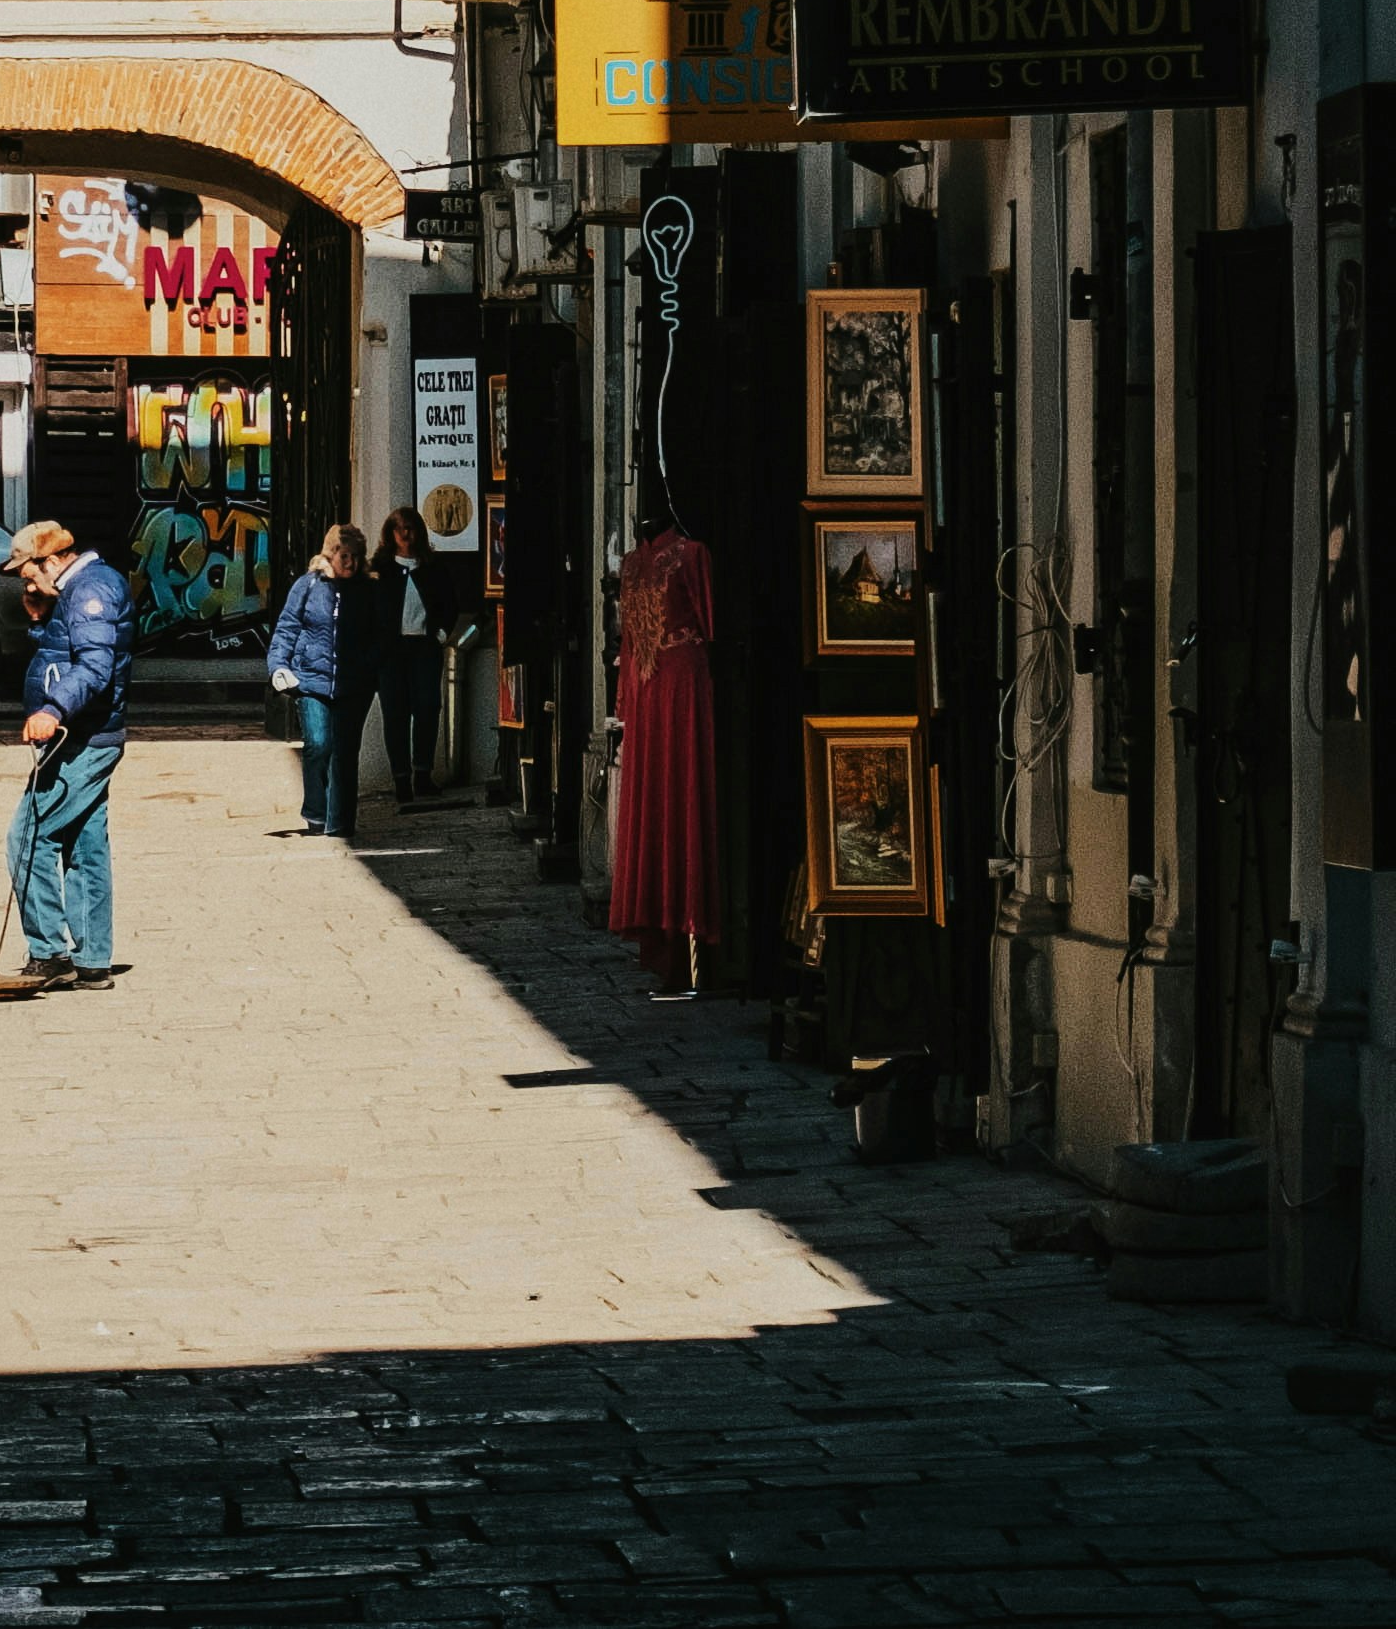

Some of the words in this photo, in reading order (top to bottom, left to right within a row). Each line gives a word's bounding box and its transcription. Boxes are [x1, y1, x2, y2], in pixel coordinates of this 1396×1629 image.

[849, 63, 945, 95] ART
[988, 54, 1205, 90] SCHOOL
[187, 307, 249, 329] CLUB
[417, 372, 445, 393] CELE
[447, 371, 474, 392] TREI
[419, 434, 475, 447] ANTIQUE
